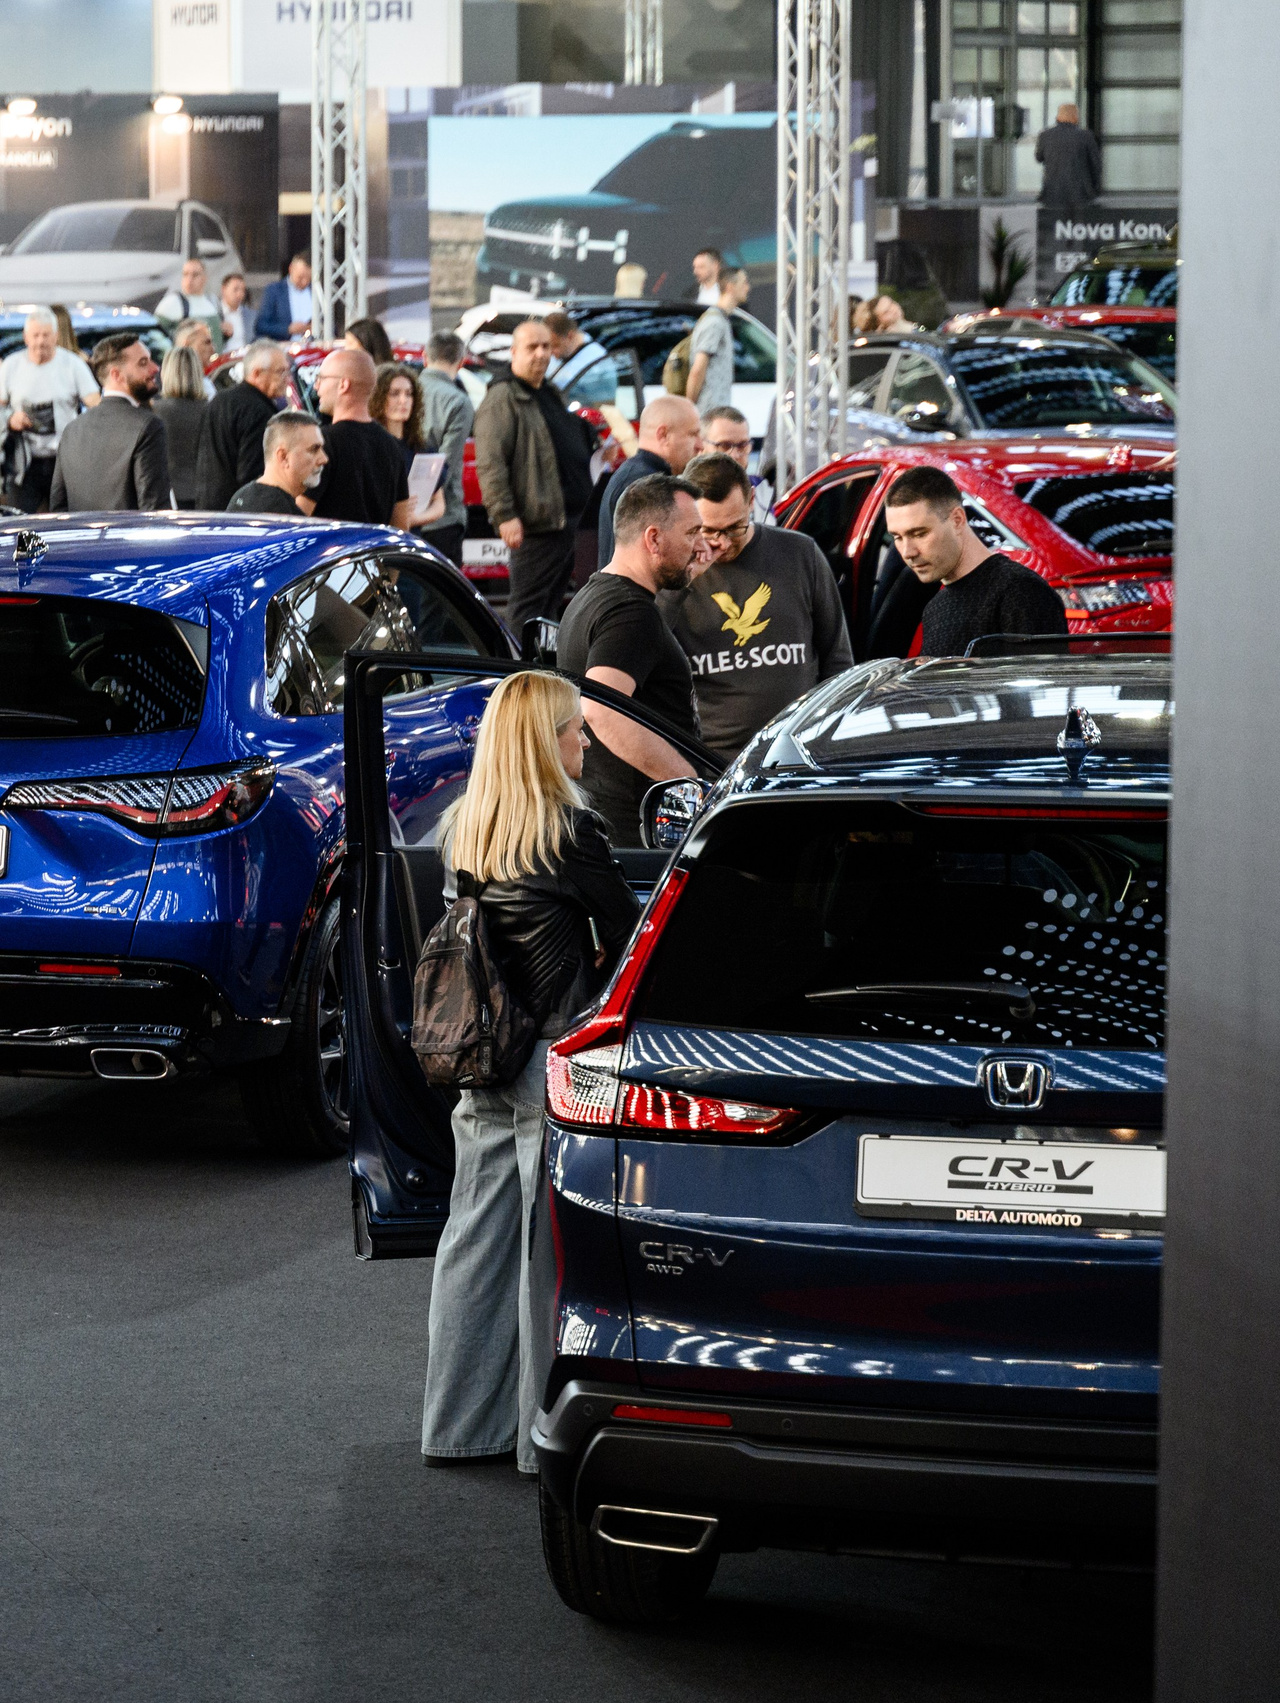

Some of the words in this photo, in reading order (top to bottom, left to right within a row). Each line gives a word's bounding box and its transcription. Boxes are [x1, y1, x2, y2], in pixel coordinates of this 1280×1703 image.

[171, 3, 217, 27] HYUNDAI
[0, 113, 73, 142] yon
[193, 115, 264, 133] HYUNDAI
[1055, 219, 1115, 240] Nova
[691, 651, 734, 675] YLE
[734, 651, 749, 669] &
[749, 643, 806, 668] SCOTT
[948, 1155, 1095, 1180] CR-V
[984, 1181, 1056, 1192] HYBRID
[955, 1209, 997, 1224] DELTA
[999, 1211, 1082, 1226] AUTOMOTO
[639, 1241, 735, 1266] CR-V
[646, 1263, 684, 1275] AWD
